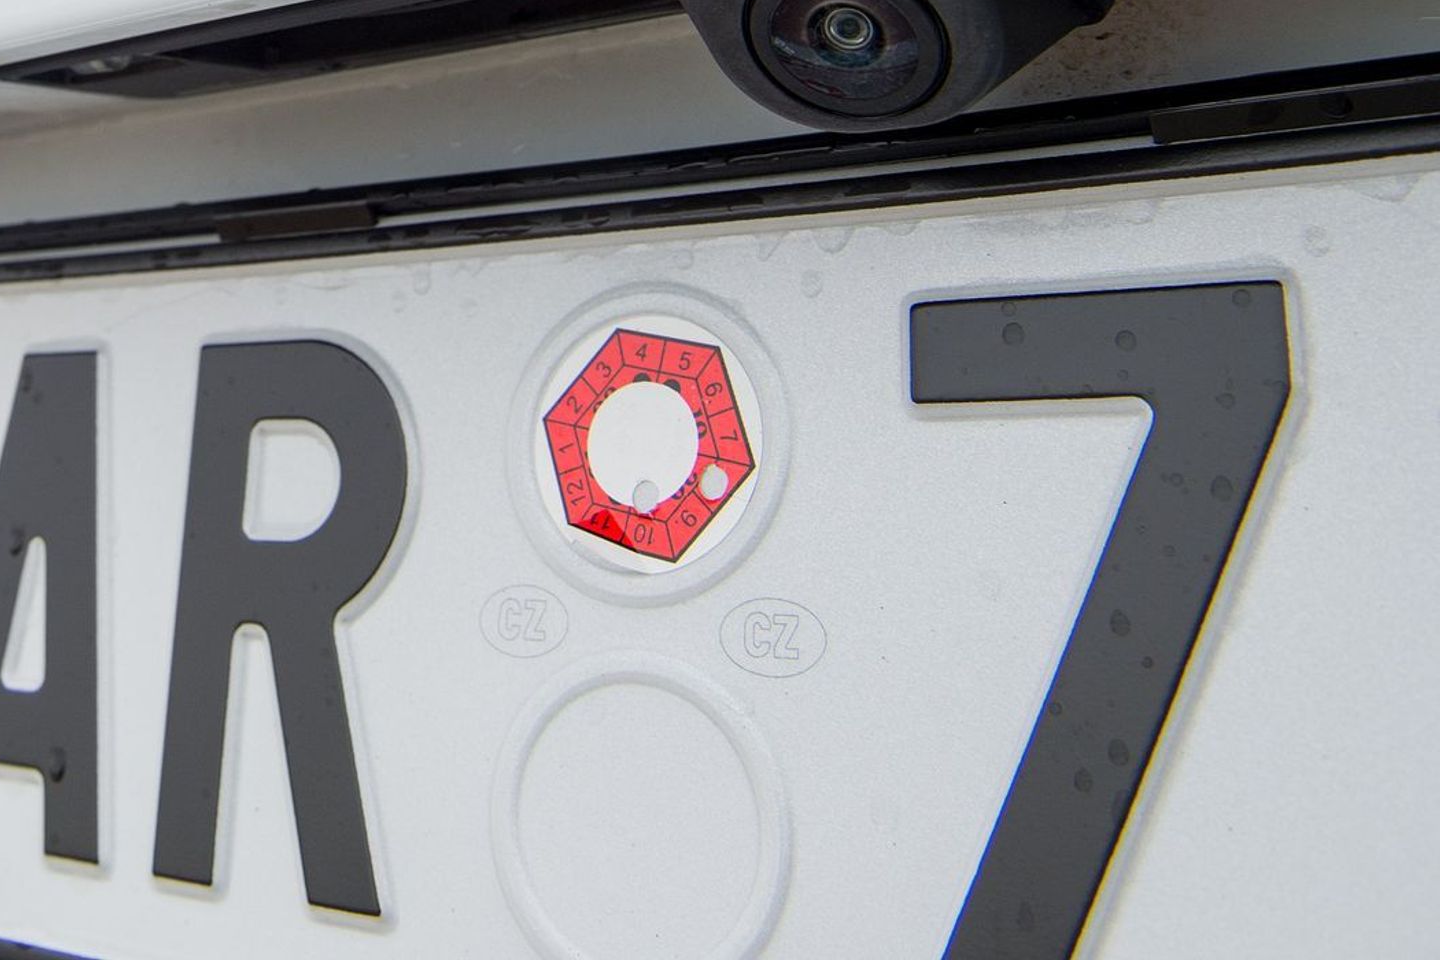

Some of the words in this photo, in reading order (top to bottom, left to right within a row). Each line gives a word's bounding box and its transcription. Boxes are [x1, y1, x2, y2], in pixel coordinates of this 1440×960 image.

[634, 343, 649, 362] 4
[678, 351, 694, 371] 5
[596, 361, 611, 378] 3
[566, 395, 584, 414] 2
[720, 429, 738, 441] 7
[566, 478, 586, 506] 12
[496, 597, 548, 642] CZ
[909, 279, 1292, 960] 7
[743, 611, 801, 661] CZ
